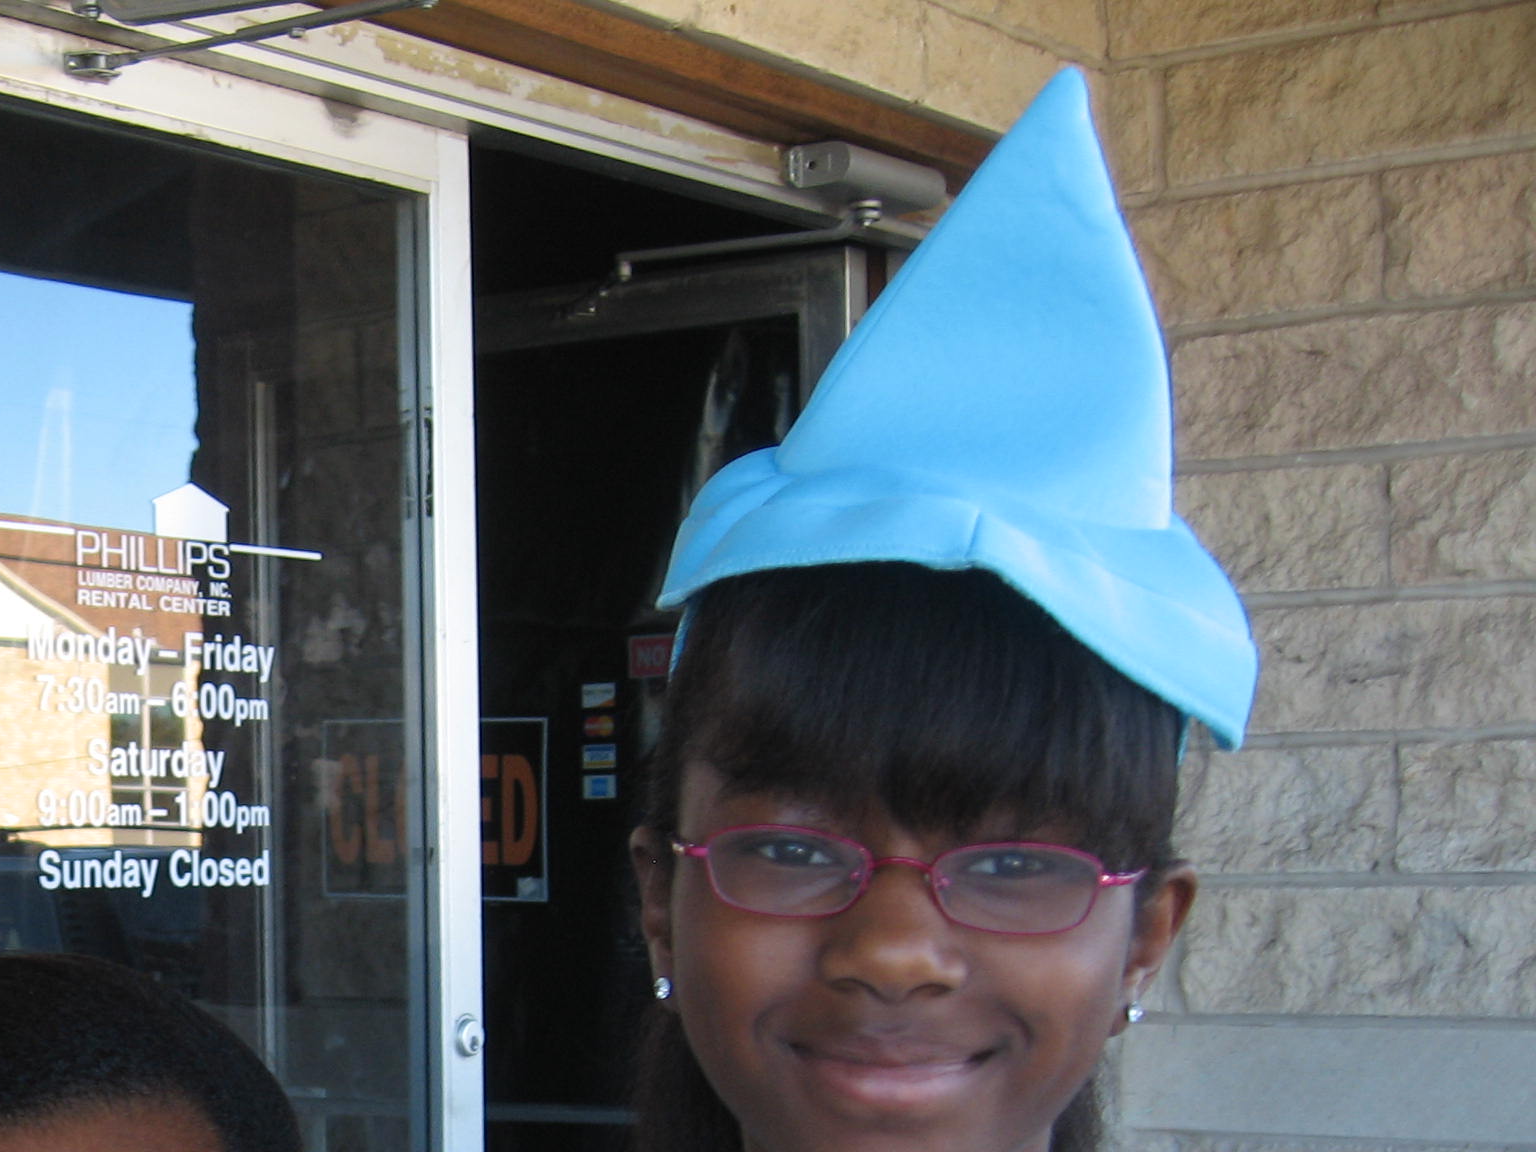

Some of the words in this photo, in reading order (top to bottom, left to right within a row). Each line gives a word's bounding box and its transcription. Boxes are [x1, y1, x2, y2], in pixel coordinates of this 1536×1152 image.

[76, 530, 232, 579] PHILLIPS
[77, 569, 133, 590] LUMBER
[77, 588, 154, 611] RENTAL
[159, 594, 232, 617] CENTER
[27, 624, 154, 675] Monday
[184, 632, 275, 682] Friday
[34, 674, 140, 715] 7:30am
[171, 681, 269, 726] 6:00pm
[88, 738, 225, 788] Saturday
[37, 790, 142, 828] 9:00am
[175, 791, 270, 834] 1:00pm
[38, 850, 159, 898] Sunday
[169, 850, 270, 888] Closed
